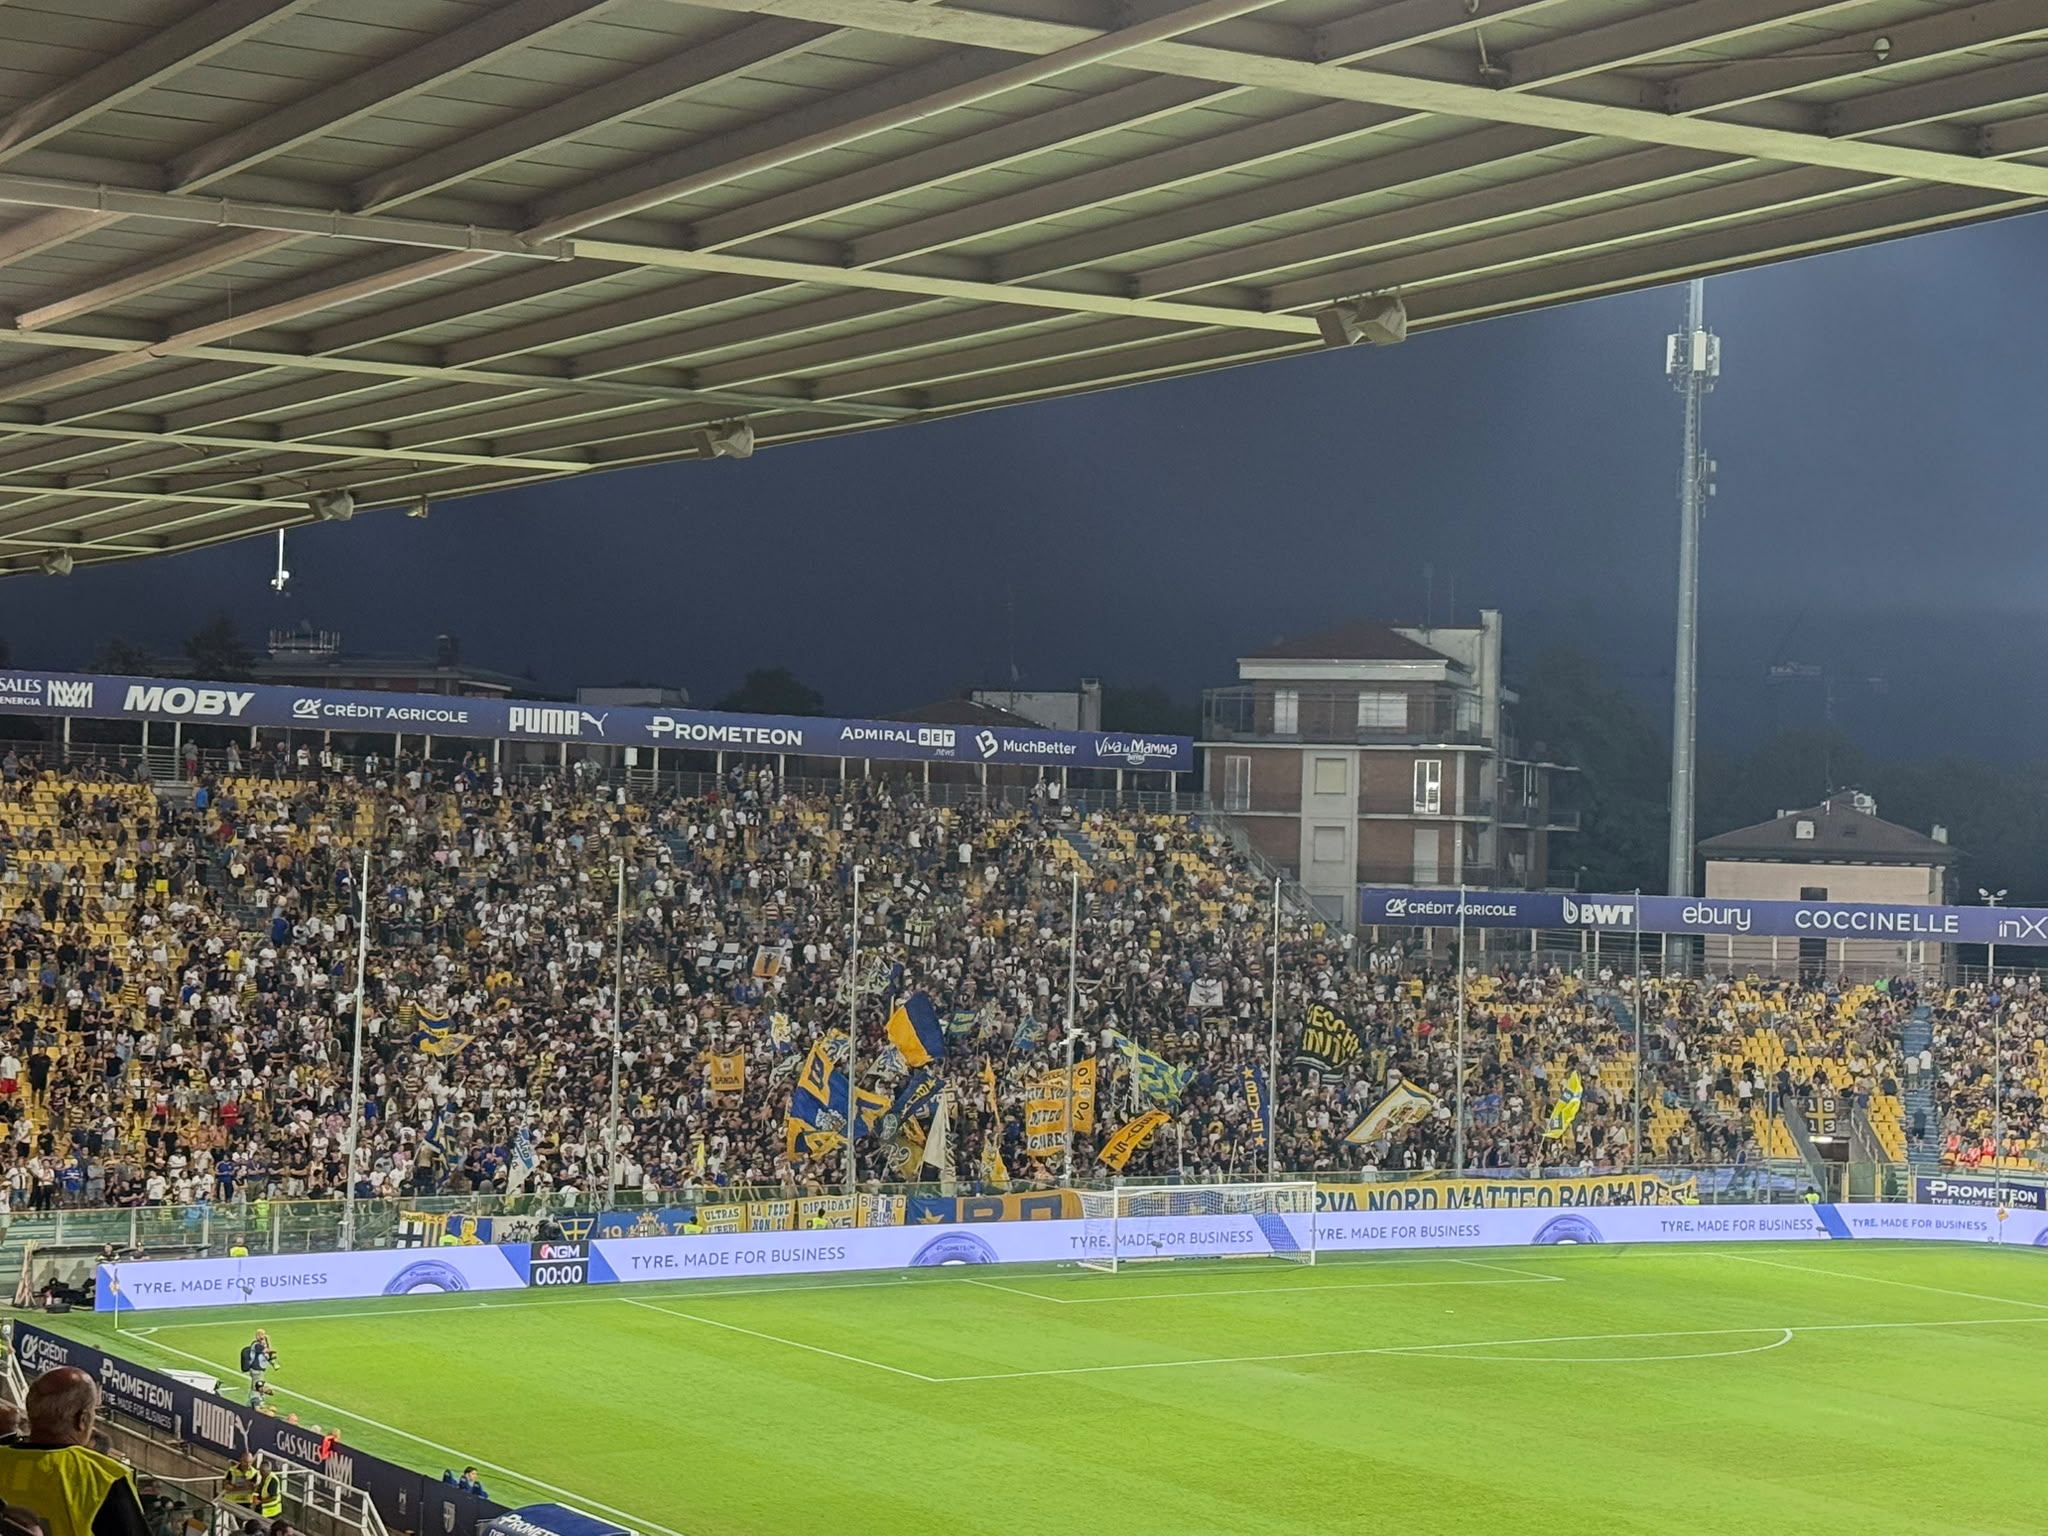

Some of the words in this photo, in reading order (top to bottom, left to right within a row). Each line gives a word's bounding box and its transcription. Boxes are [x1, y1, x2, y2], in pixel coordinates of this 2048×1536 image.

[123, 685, 255, 716] MOBY
[323, 701, 384, 719] CRÉDIT
[386, 705, 468, 724] AGRICOLE
[508, 706, 580, 736] PUMA
[645, 716, 803, 747] PROMETEON
[840, 726, 916, 743] ADMIRAL
[1003, 739, 1077, 756] MuchBetter
[1095, 737, 1122, 756] Viva
[1408, 901, 1454, 915] CRÉDIT
[1581, 904, 1634, 925] BWT
[1682, 902, 1751, 930] ebury
[1795, 909, 1959, 934] COCCINELLE
[1244, 1080, 1264, 1132] BOYS
[1808, 1099, 1835, 1112] 19
[1809, 1120, 1836, 1132] 13
[1368, 1188, 1438, 1211] NORD
[1447, 1182, 1553, 1210] MATTEO
[1925, 1180, 2039, 1204] PROMETEON
[704, 1208, 740, 1221] ULTRAS
[751, 1204, 762, 1217] LA
[768, 1202, 790, 1217] FEDE
[752, 1218, 771, 1231] NON
[1351, 1226, 1388, 1239] MADE
[1391, 1226, 1417, 1239] FOR
[1420, 1224, 1481, 1238] BUSINESS
[1661, 1220, 1694, 1232] TYRE.
[1697, 1220, 1730, 1232] MADE
[1733, 1219, 1756, 1231] FOR
[1759, 1218, 1814, 1231] BUSINESS
[1880, 1218, 1909, 1228] MADE
[1911, 1218, 1932, 1229] FOR
[1935, 1219, 1988, 1231] BUSINESS
[1070, 1235, 1111, 1249] TYRE.
[1116, 1233, 1154, 1247] MADE
[1159, 1232, 1186, 1246] FOR
[1190, 1230, 1254, 1244] BUSINESS
[631, 1254, 679, 1270] TYRE.
[684, 1251, 730, 1267] MADE
[735, 1250, 766, 1264] FOR
[771, 1246, 846, 1263] BUSINESS
[133, 1282, 177, 1294] TYRE.
[181, 1279, 223, 1292] MADE
[227, 1277, 256, 1290] FOR
[260, 1273, 328, 1288] BUSINESS
[536, 1265, 583, 1286] 00:00
[100, 1358, 174, 1411] PROMETEON
[117, 1396, 133, 1412] MADE
[133, 1401, 146, 1416] FOR
[144, 1407, 172, 1429] BUSINESS
[192, 1396, 236, 1450] PUMA
[276, 1430, 297, 1455] GAS
[296, 1439, 323, 1465] SALES
